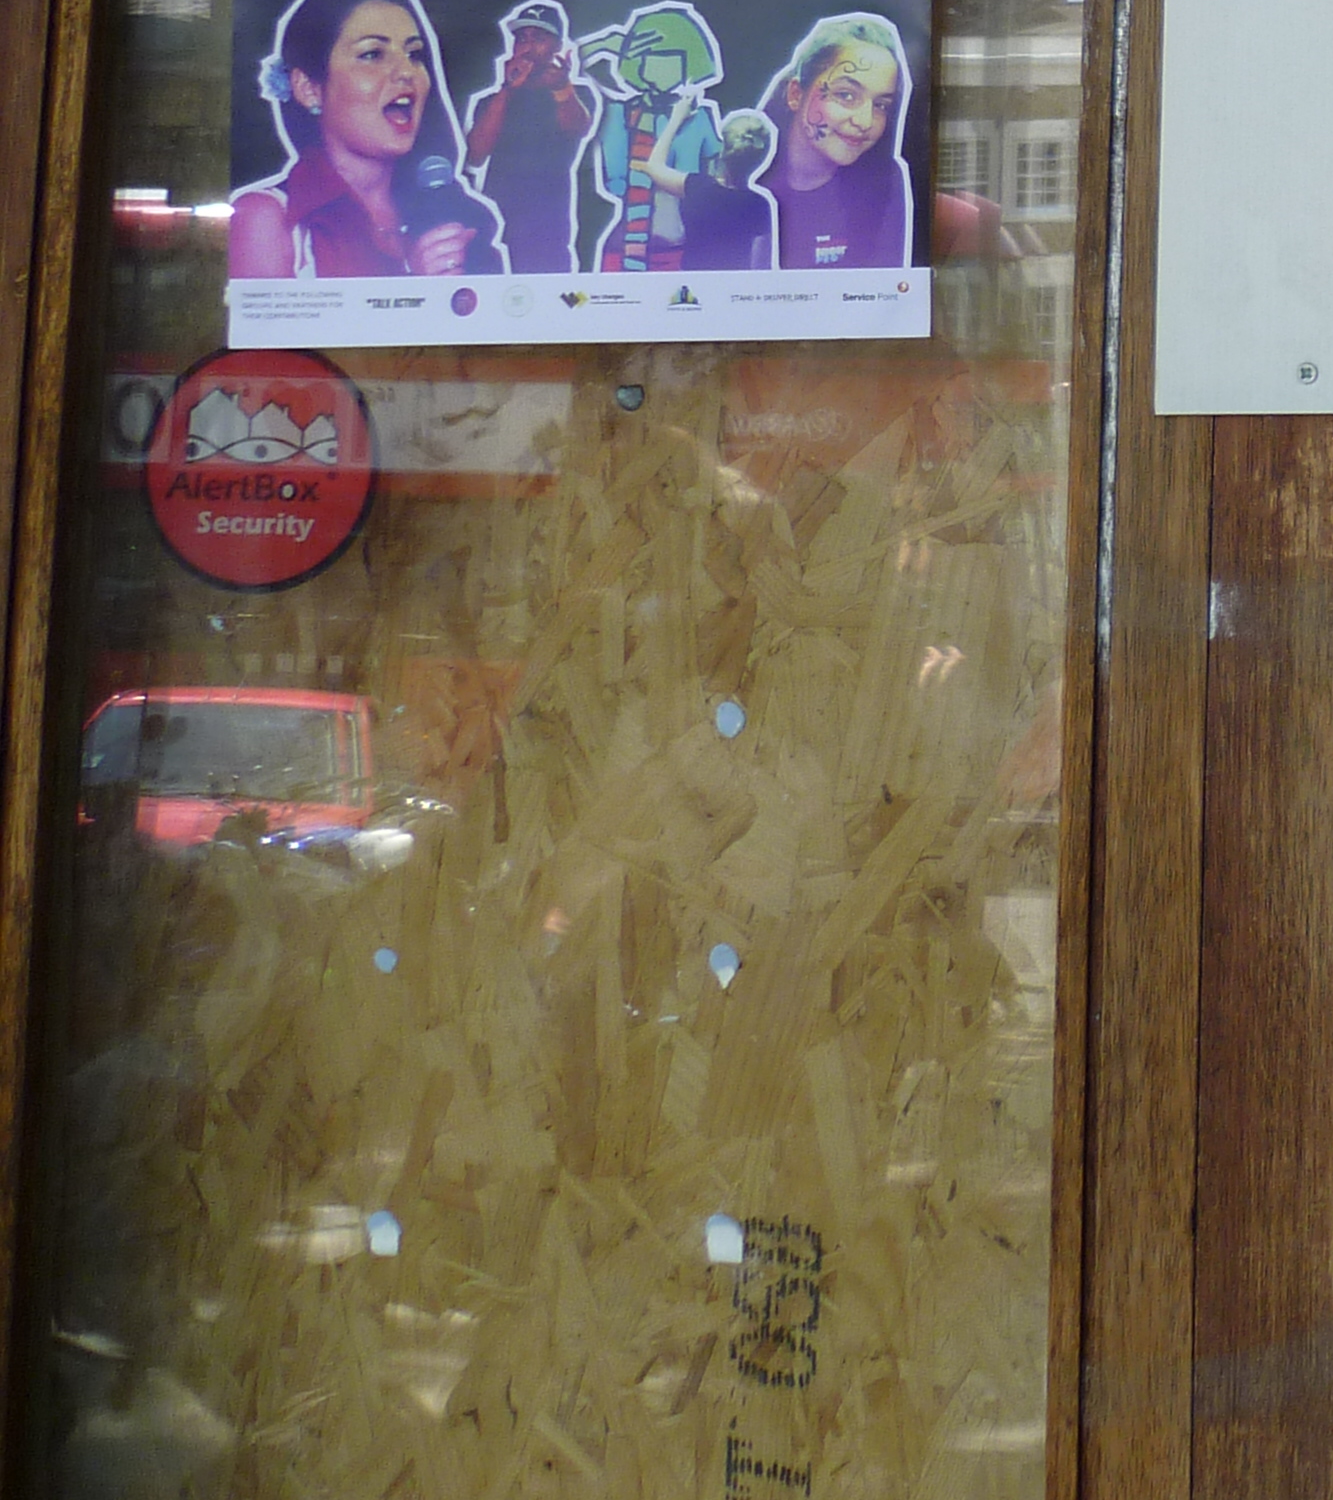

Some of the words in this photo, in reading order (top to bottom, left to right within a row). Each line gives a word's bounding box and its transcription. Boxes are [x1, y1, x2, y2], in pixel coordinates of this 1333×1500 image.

[842, 292, 876, 302] Service
[166, 472, 320, 502] AlertBox
[197, 511, 315, 541] Security
